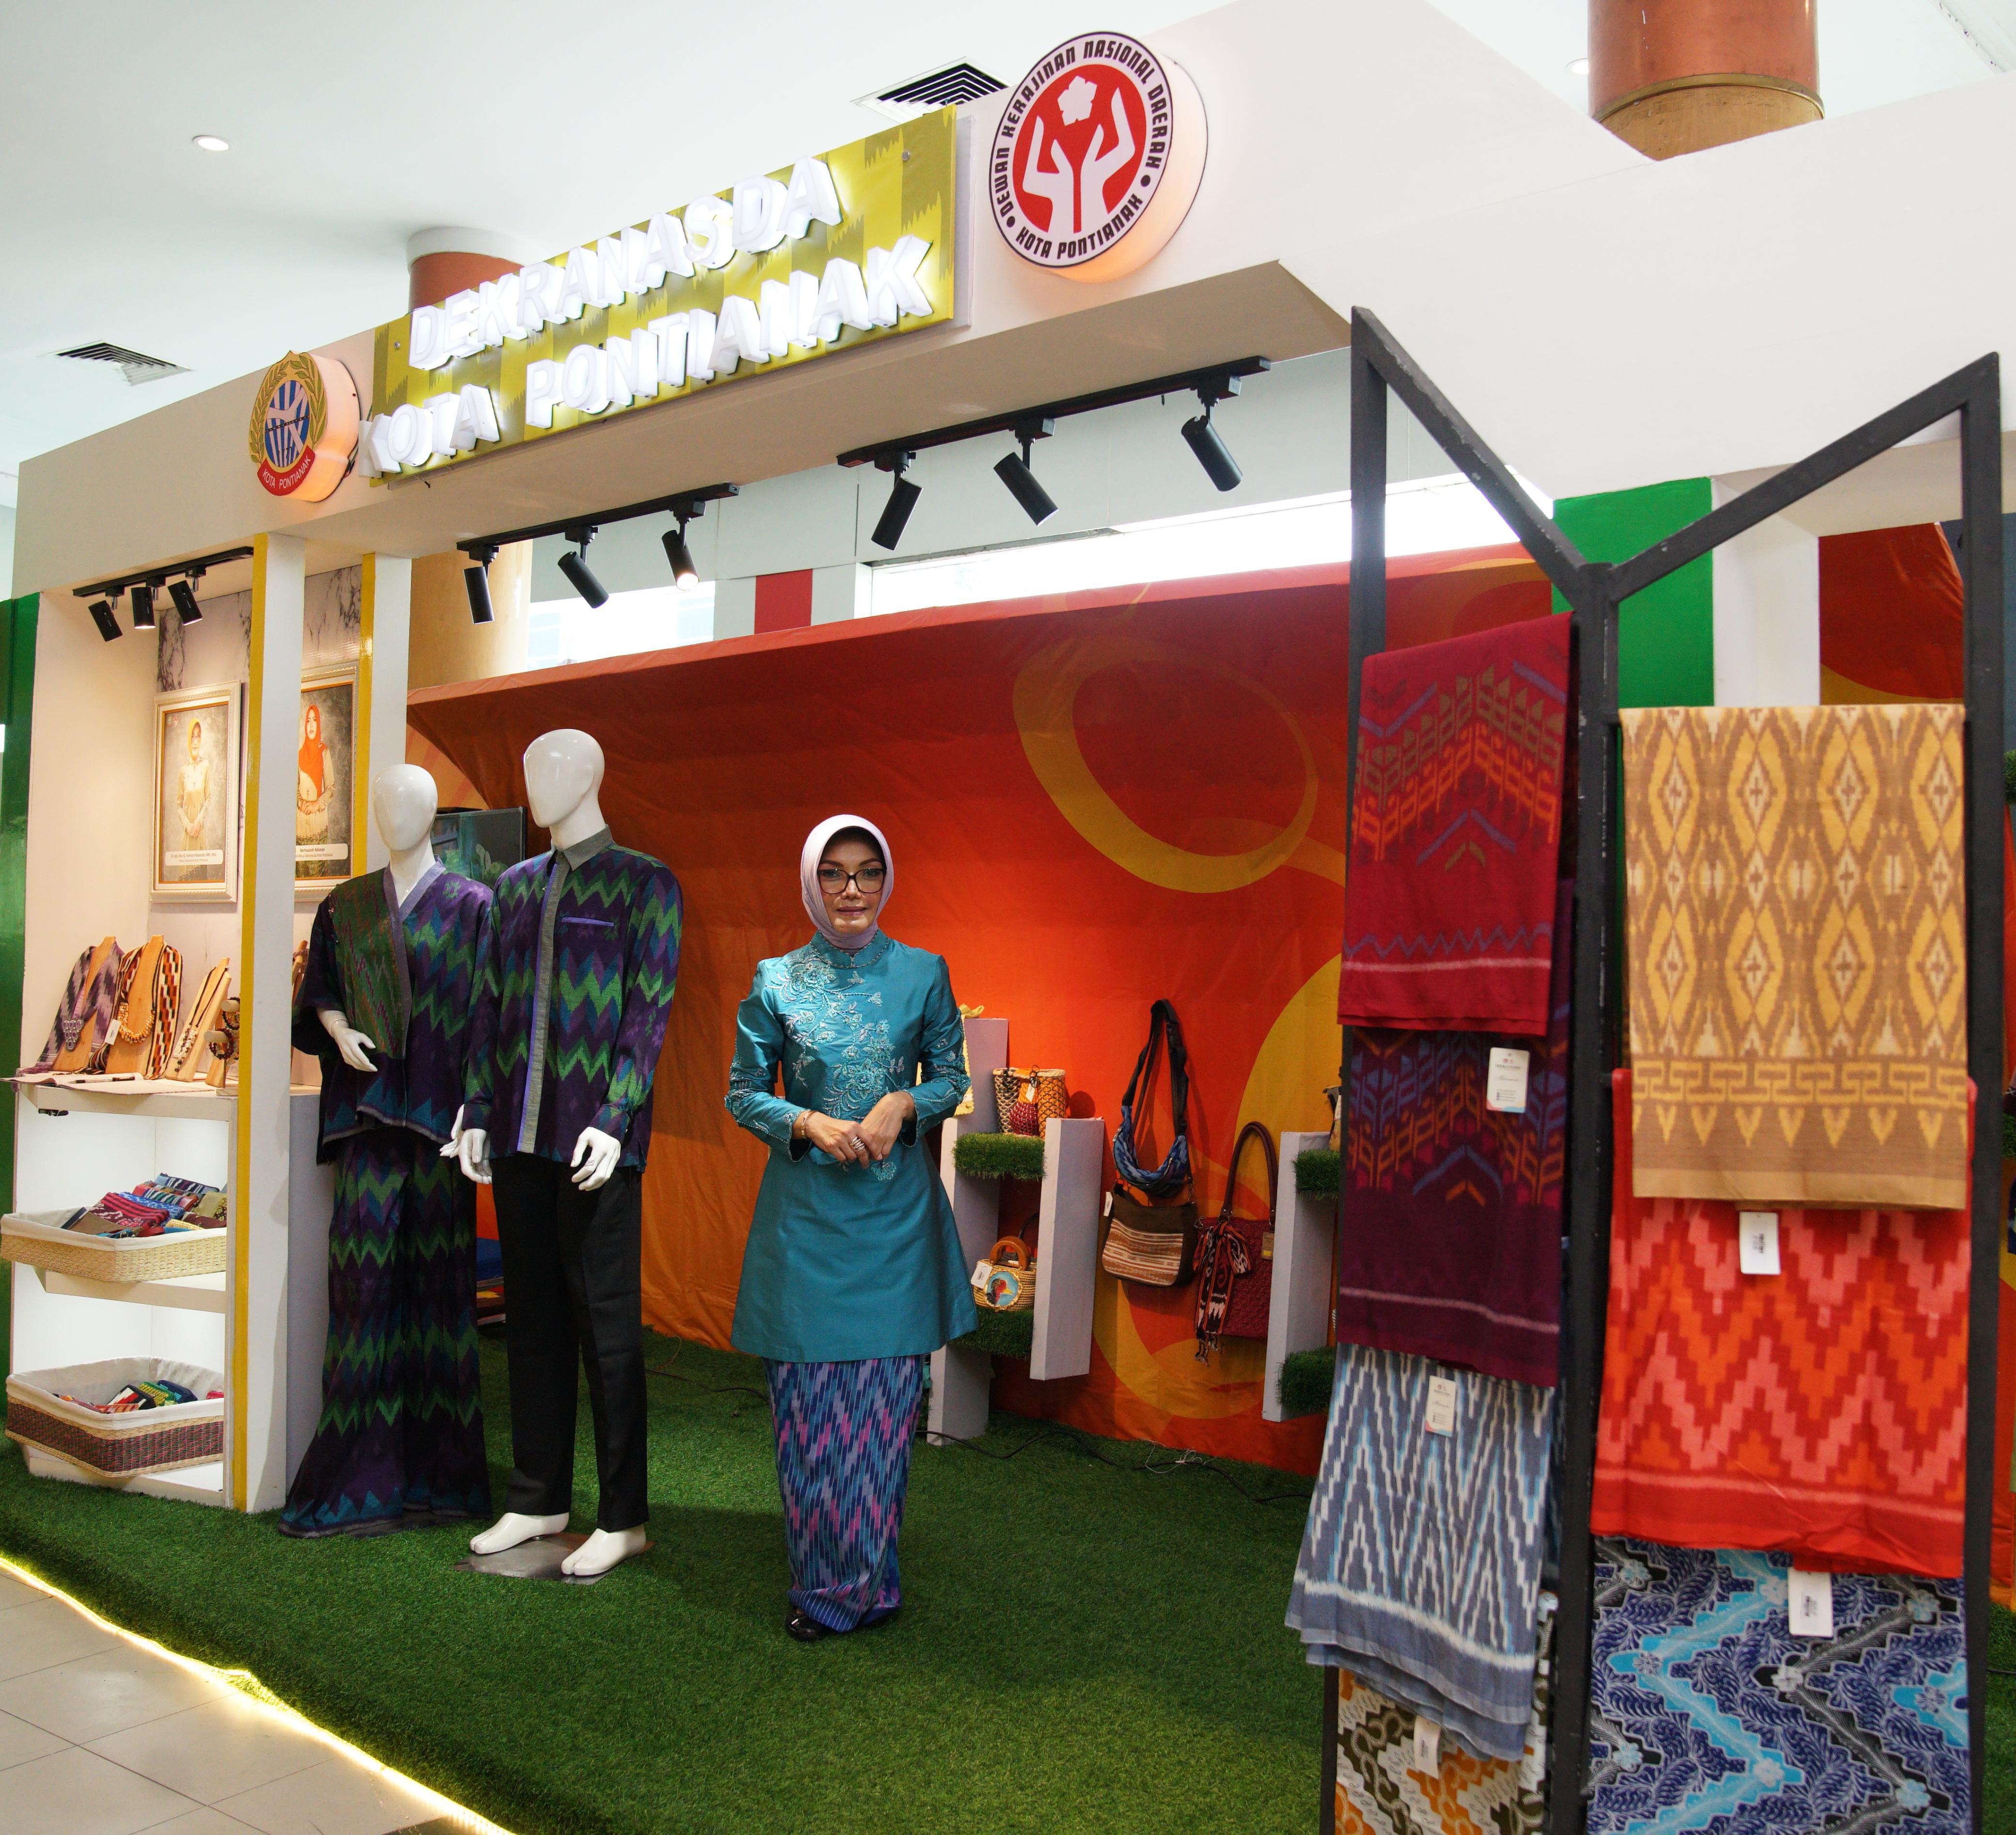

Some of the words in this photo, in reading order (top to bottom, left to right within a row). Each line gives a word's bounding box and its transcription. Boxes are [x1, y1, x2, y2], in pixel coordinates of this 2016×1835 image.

[1001, 46, 1076, 139] KERAJINAN
[1083, 40, 1155, 84] NASIONAL
[1146, 83, 1168, 168] DAERAH
[994, 147, 1014, 217] DEWAN
[408, 155, 842, 371] DEKRANASDA
[1016, 226, 1052, 259] KOTA
[1057, 193, 1144, 260] PONTIANAK
[358, 384, 501, 479] KOTA
[525, 234, 933, 428] PONTIANAK
[262, 469, 276, 488] KOTA
[279, 455, 311, 490] PONTIANAK
